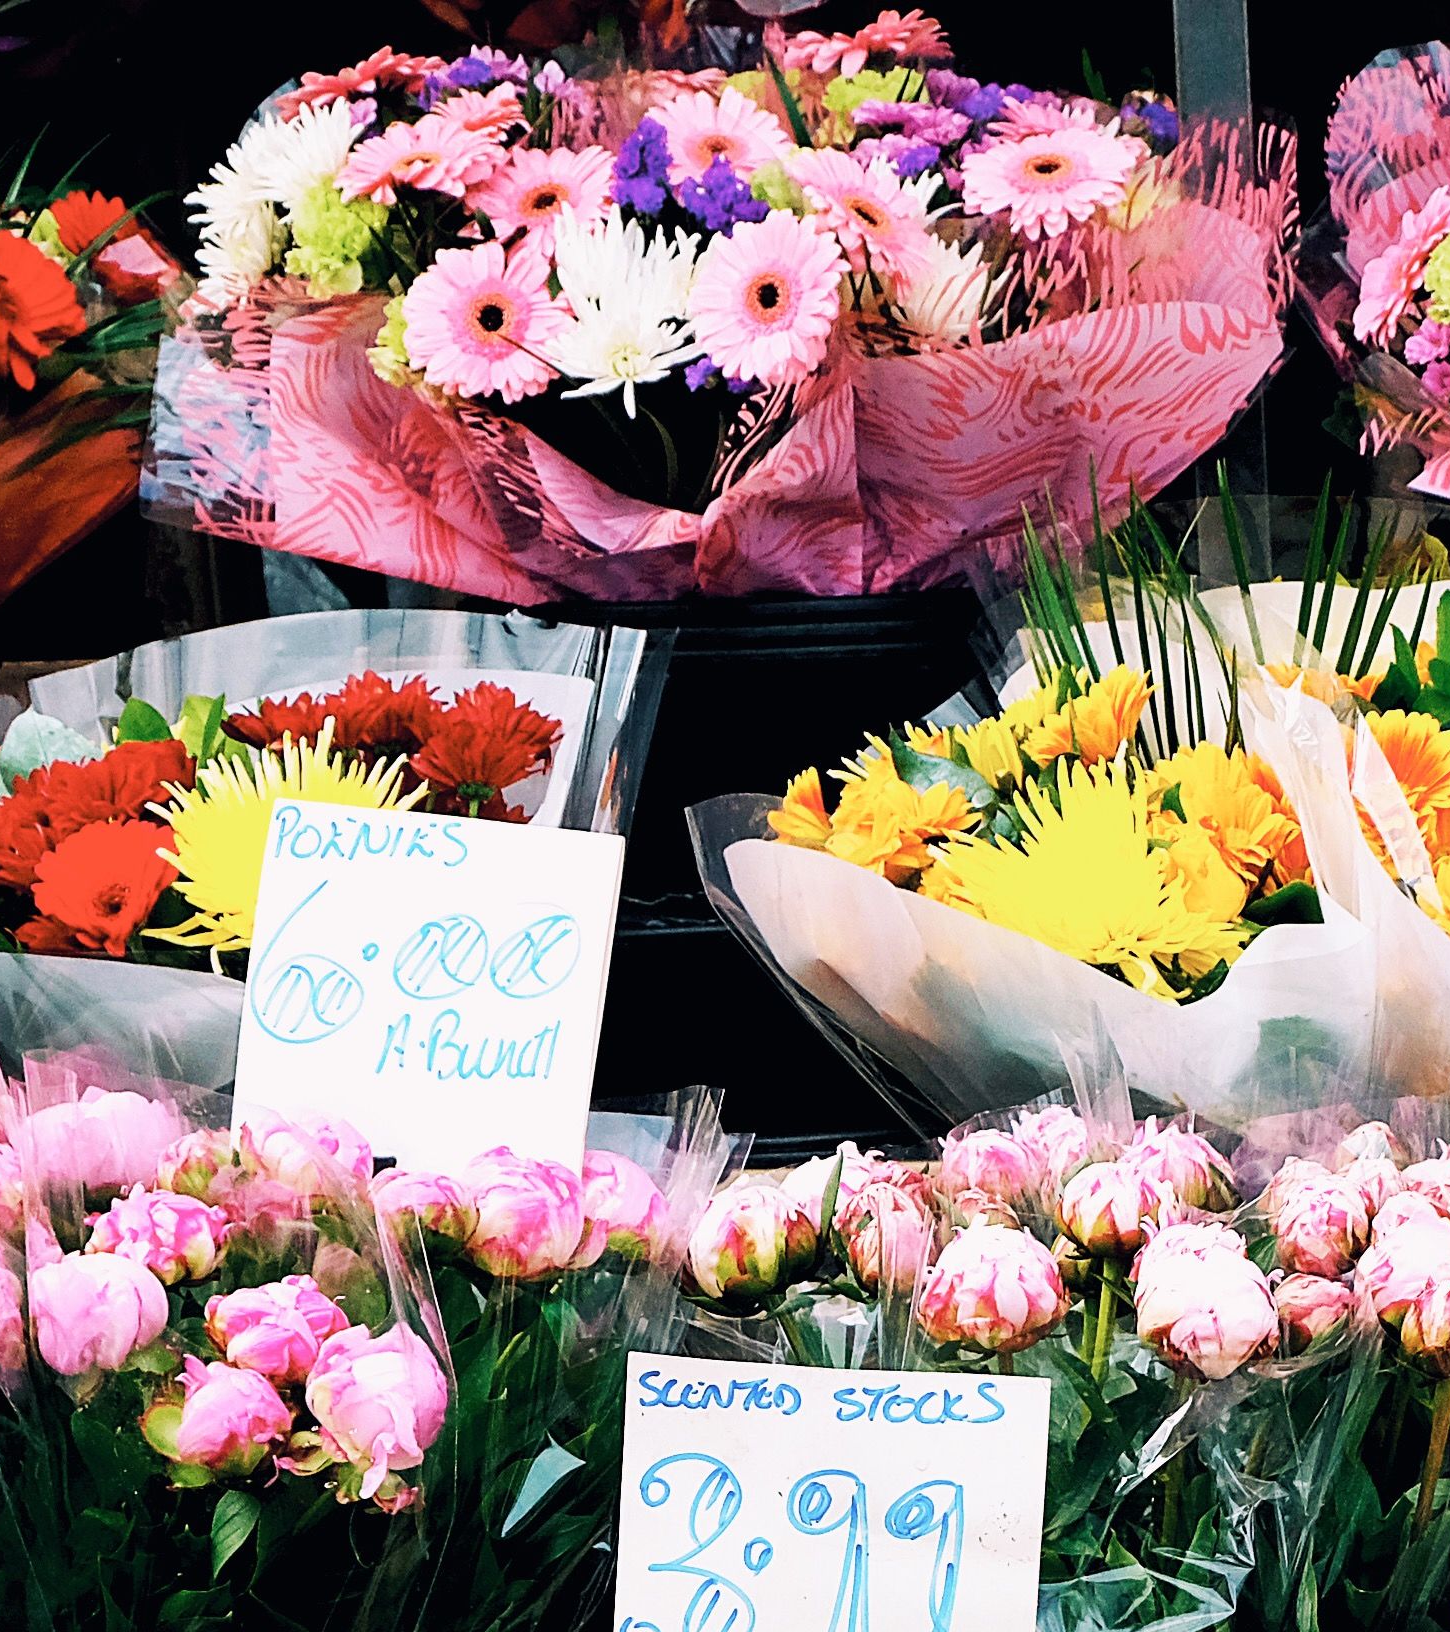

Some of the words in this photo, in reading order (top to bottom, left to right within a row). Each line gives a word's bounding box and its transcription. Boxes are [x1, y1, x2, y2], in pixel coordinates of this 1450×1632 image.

[251, 880, 581, 1044] 6.00
[638, 1370, 801, 1416] SCENTED
[834, 1382, 1004, 1424] STOCKS
